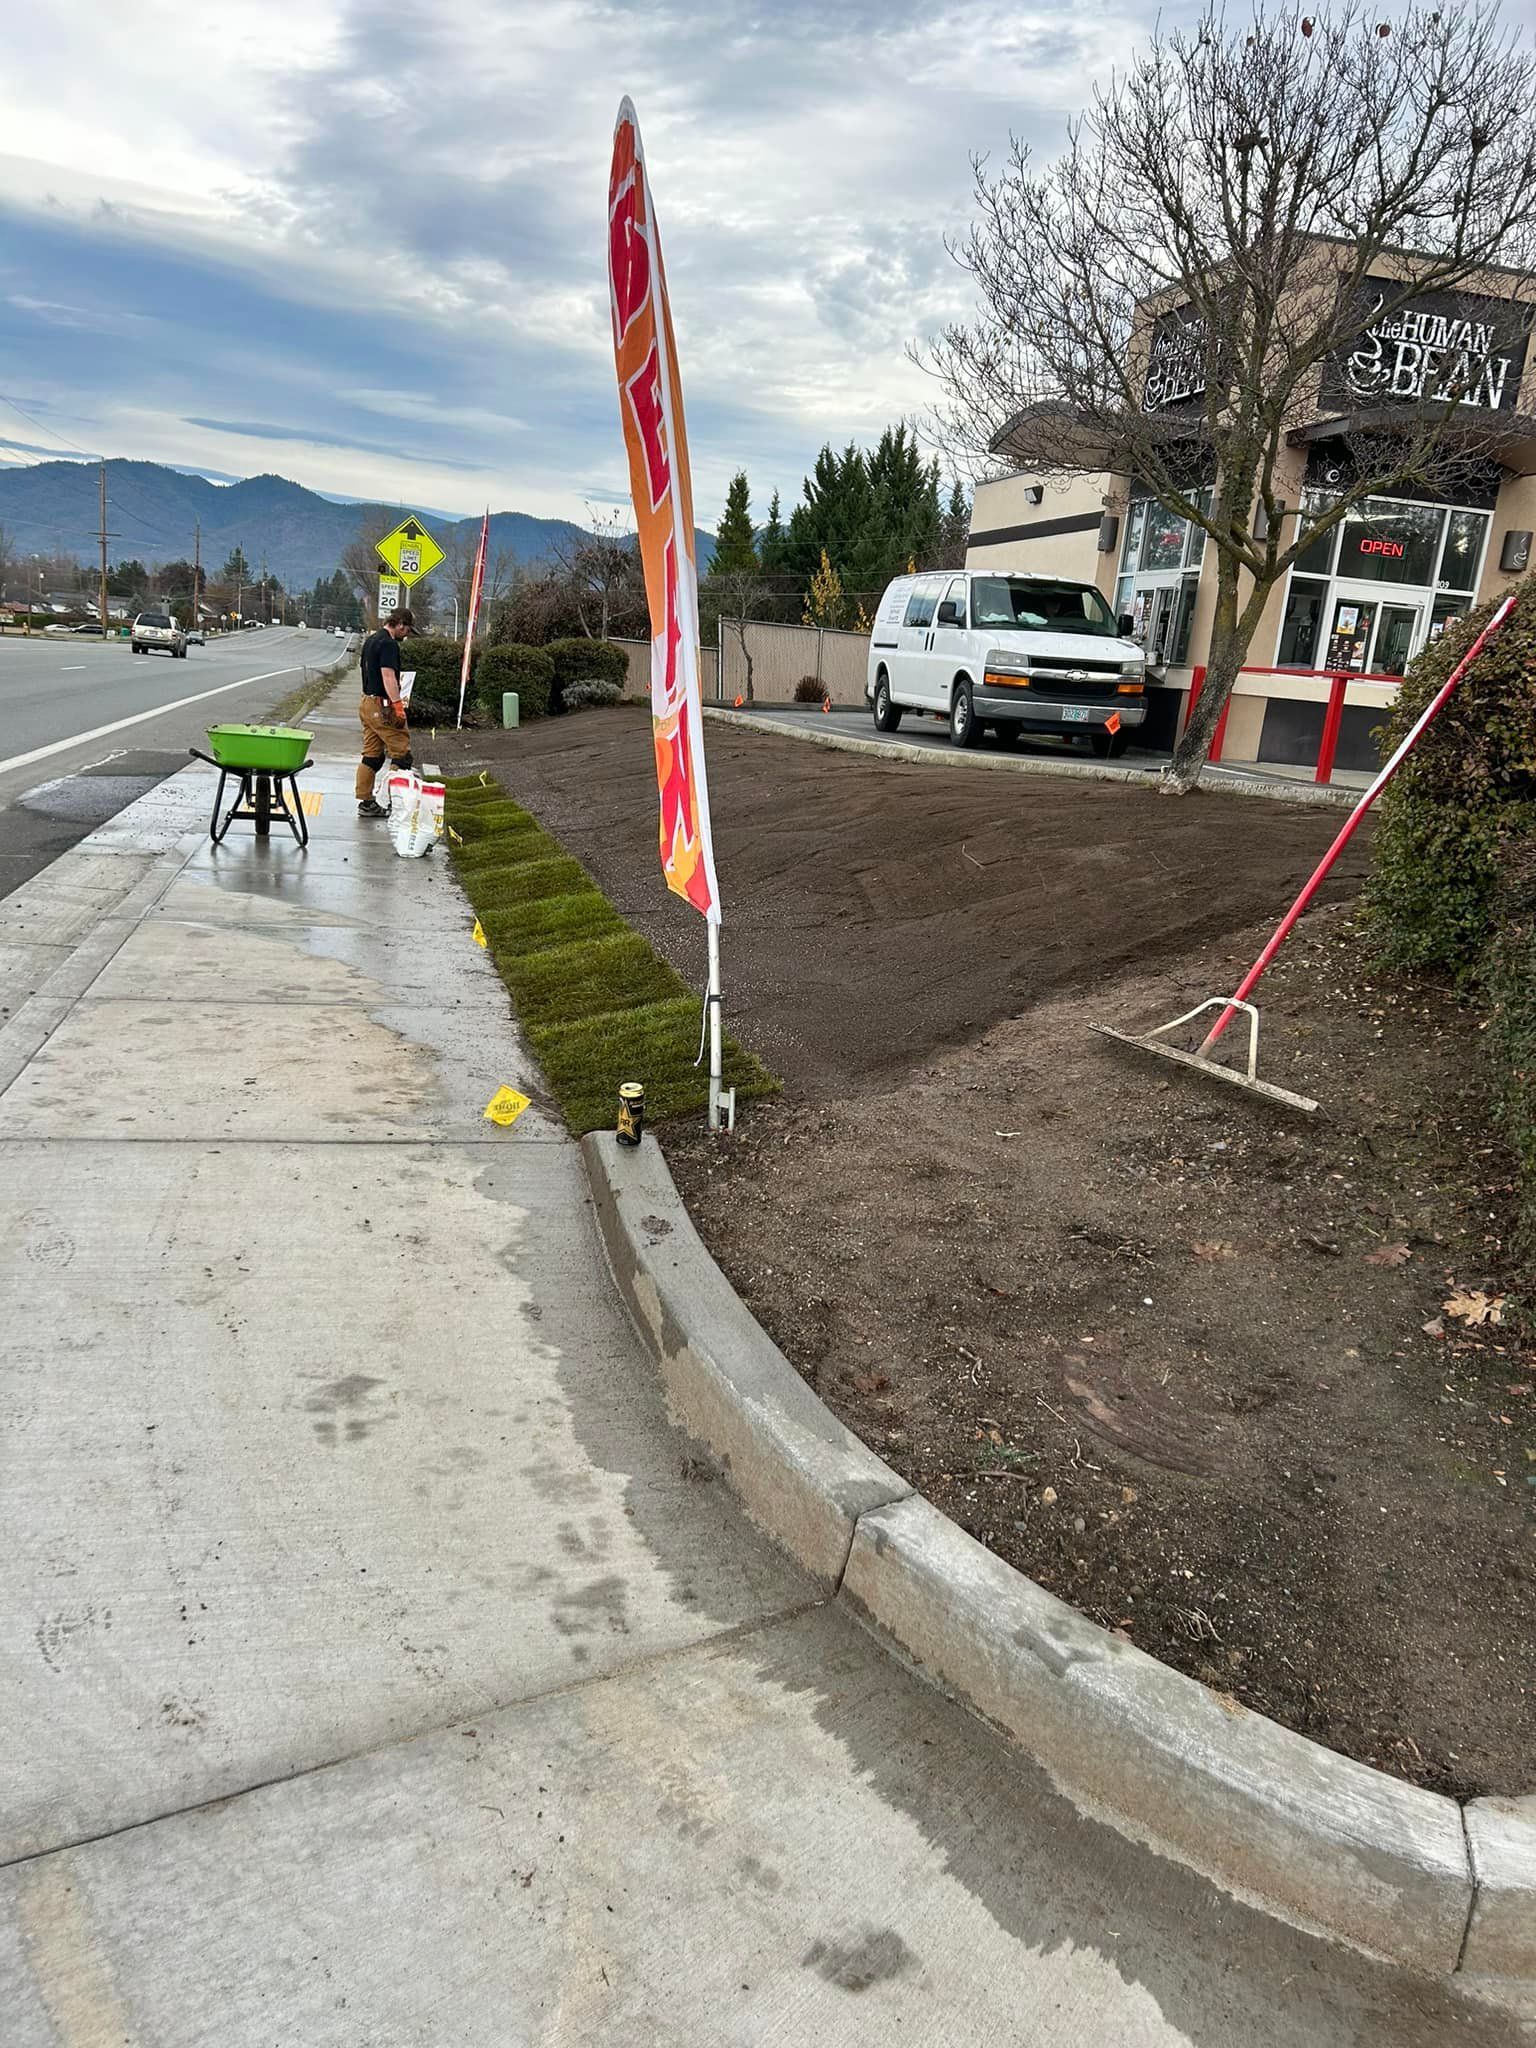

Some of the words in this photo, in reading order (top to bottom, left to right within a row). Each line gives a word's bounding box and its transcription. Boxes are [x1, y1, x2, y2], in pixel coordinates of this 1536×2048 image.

[1399, 310, 1496, 354] HUMAN
[1385, 341, 1511, 410] BEAN
[1360, 539, 1404, 557] OPEN
[401, 560, 418, 572] 20
[381, 597, 396, 607] 20
